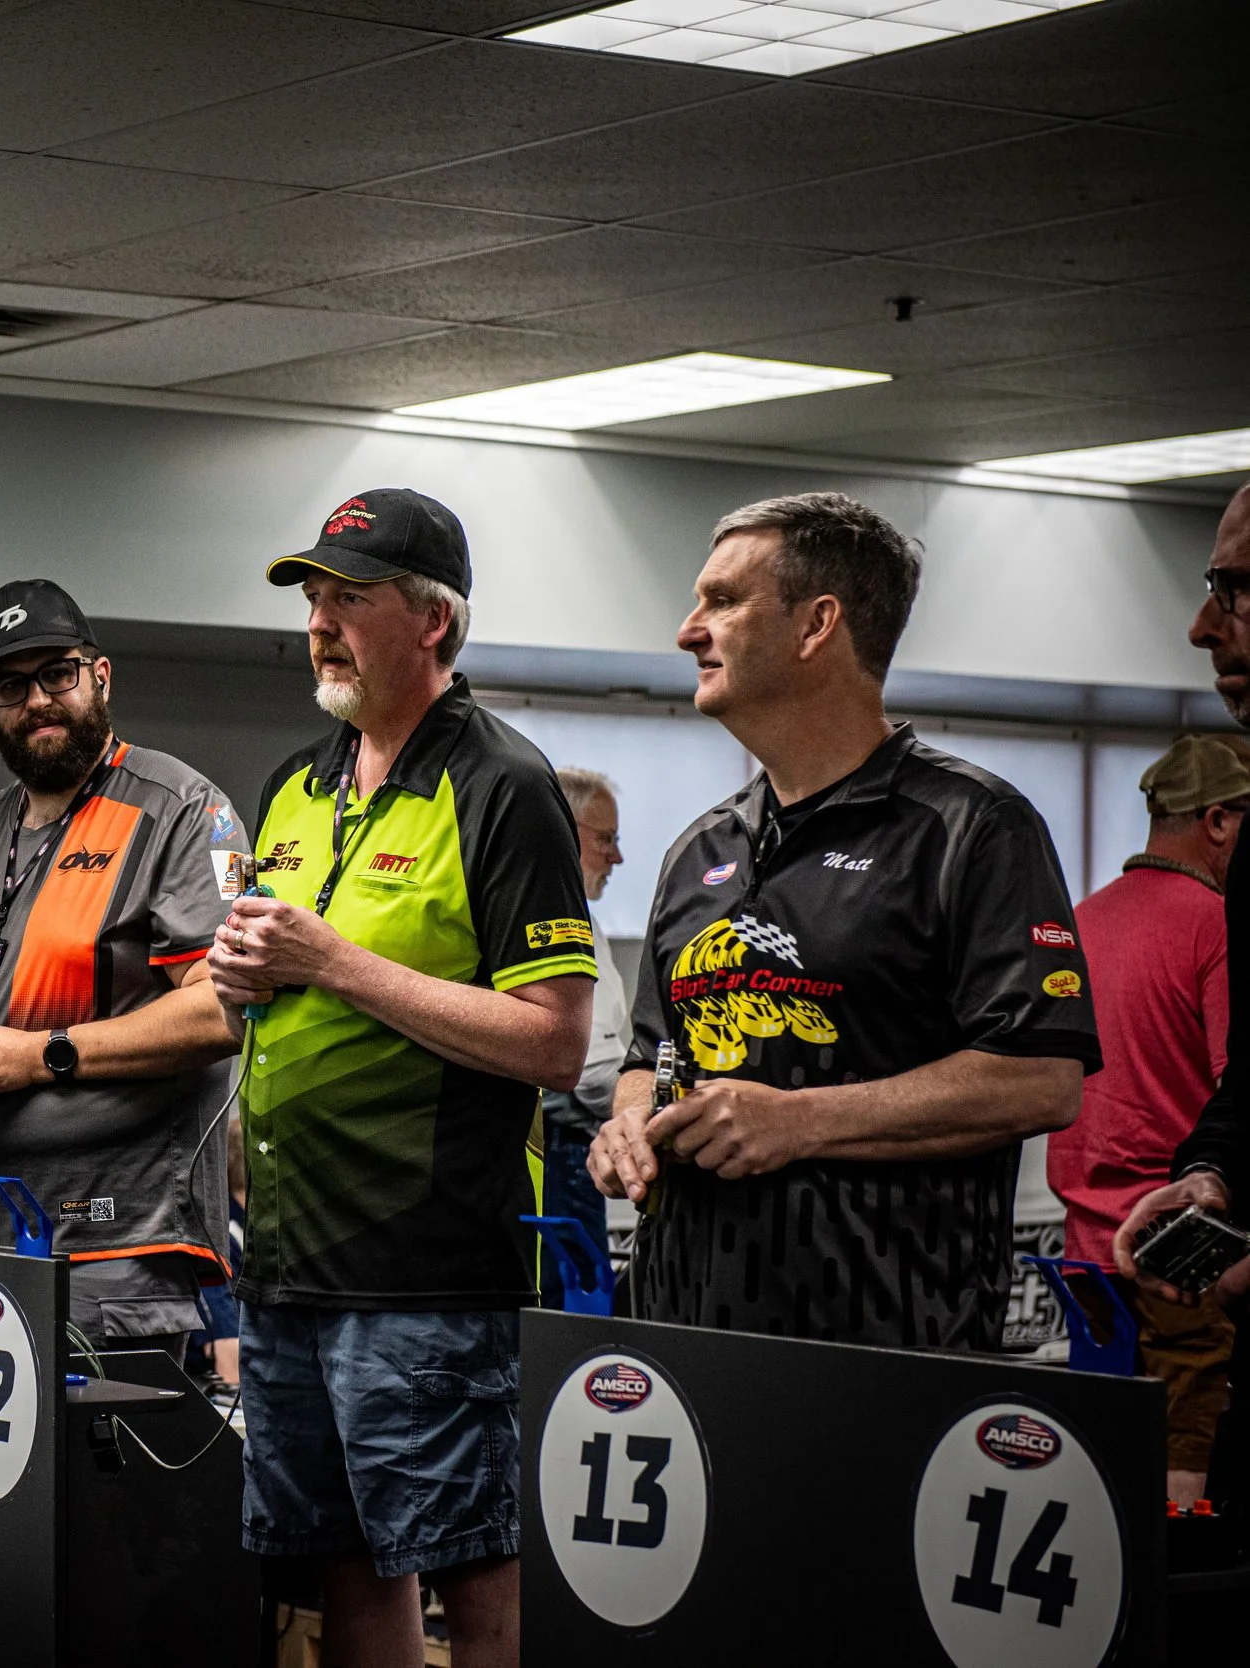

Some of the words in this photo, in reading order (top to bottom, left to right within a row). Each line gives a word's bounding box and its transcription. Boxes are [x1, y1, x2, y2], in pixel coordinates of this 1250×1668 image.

[822, 852, 874, 871] Matt
[1032, 927, 1076, 946] NSR
[671, 978, 708, 1002] Slot
[712, 967, 747, 990] Car
[749, 969, 844, 997] Corner
[590, 1377, 647, 1394] AMSCO
[984, 1427, 1055, 1453] AMSCO
[572, 1432, 672, 1549] 13
[951, 1486, 1078, 1629] 14
